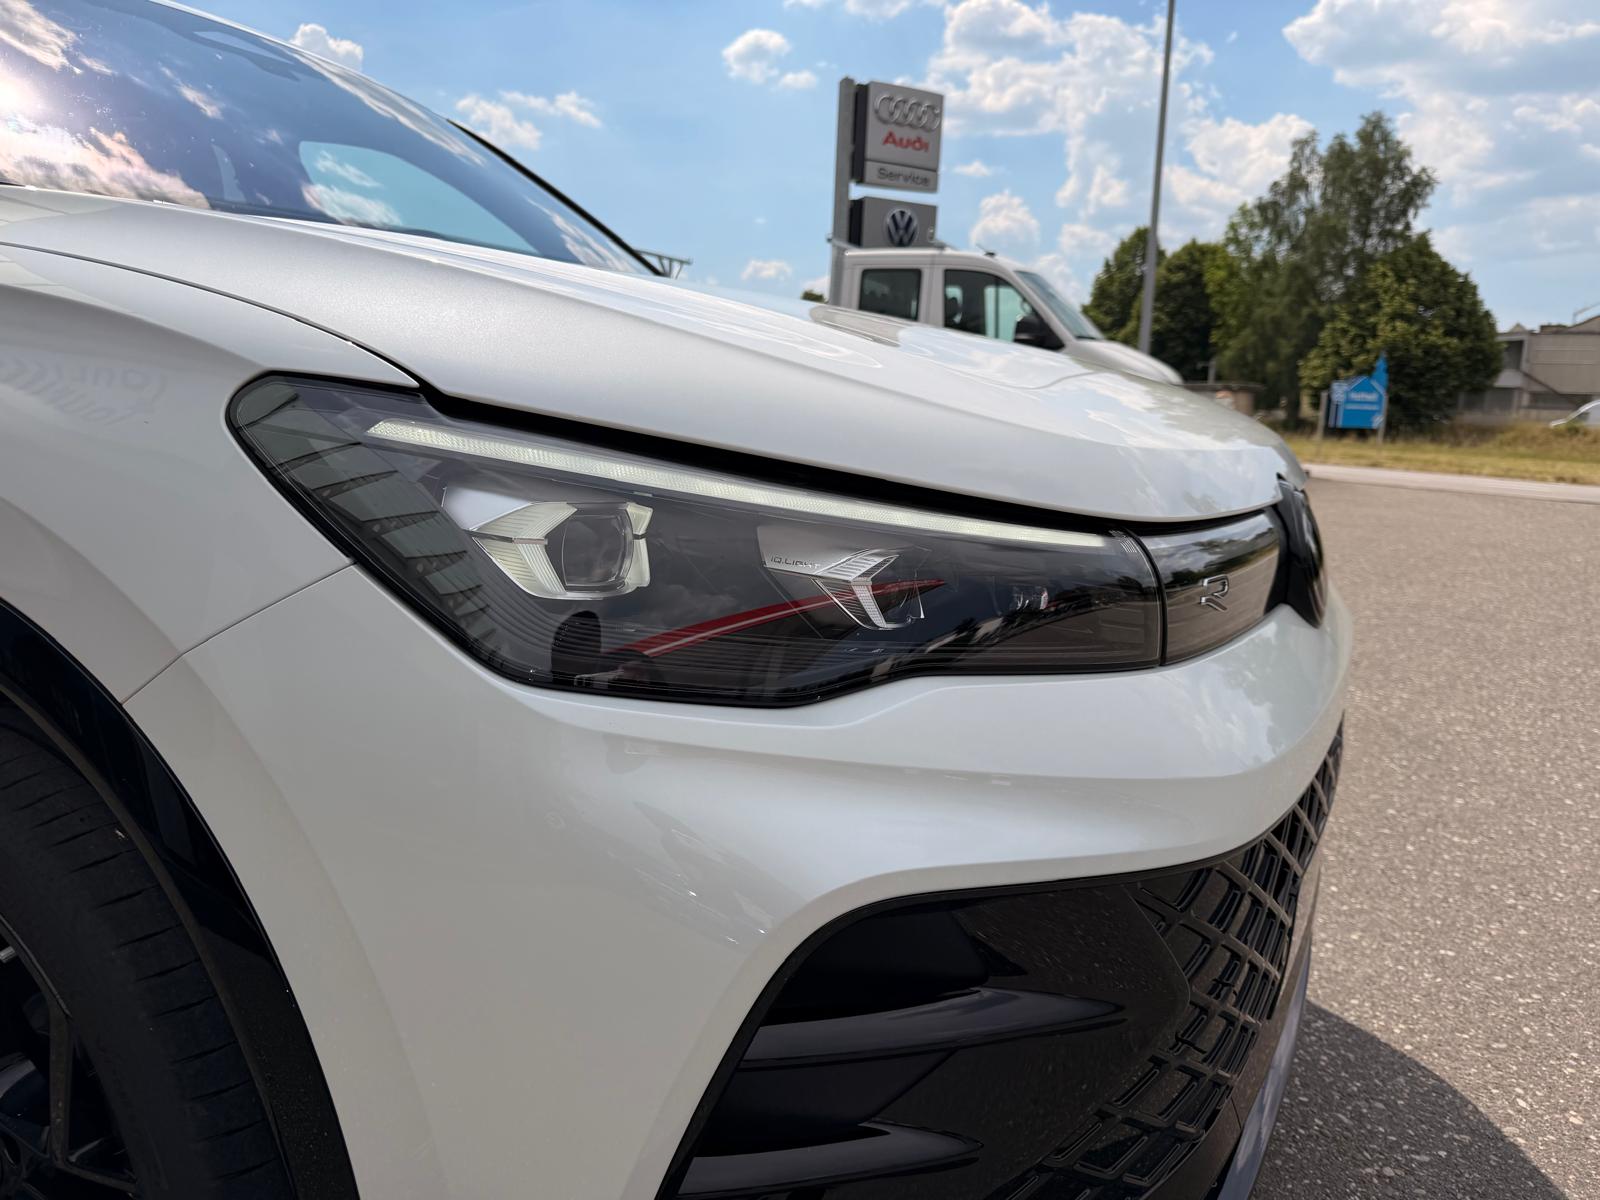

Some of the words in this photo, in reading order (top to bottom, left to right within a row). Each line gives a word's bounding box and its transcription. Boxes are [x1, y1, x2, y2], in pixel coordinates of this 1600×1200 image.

[883, 131, 929, 152] Audi
[878, 168, 929, 186] Service
[1200, 573, 1229, 612] R
